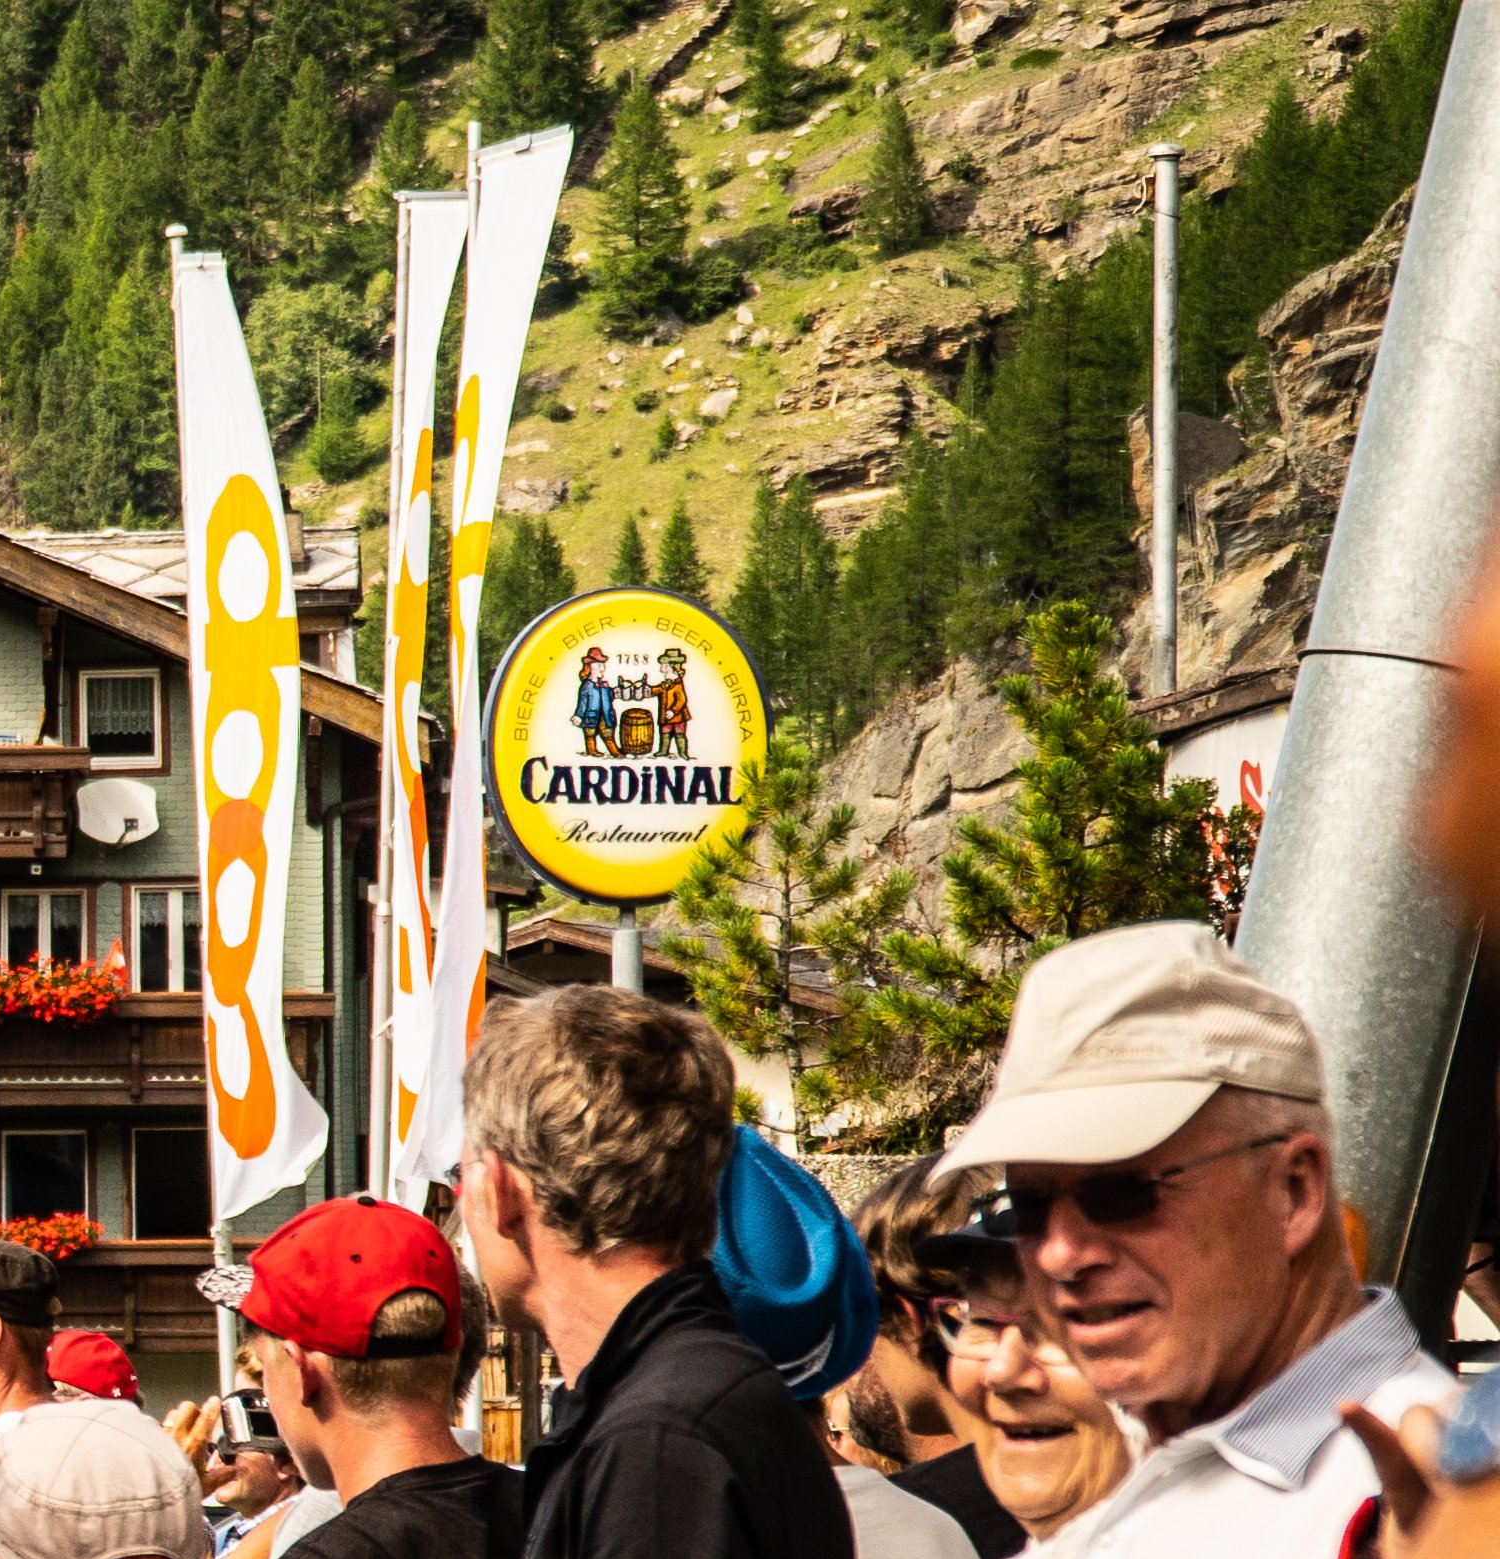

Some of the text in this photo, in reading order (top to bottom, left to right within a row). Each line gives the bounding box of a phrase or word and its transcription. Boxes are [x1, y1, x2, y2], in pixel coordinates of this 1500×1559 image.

[514, 615, 754, 744] BIERE BIER BEER BIRRA
[555, 818, 710, 844] Restaurant
